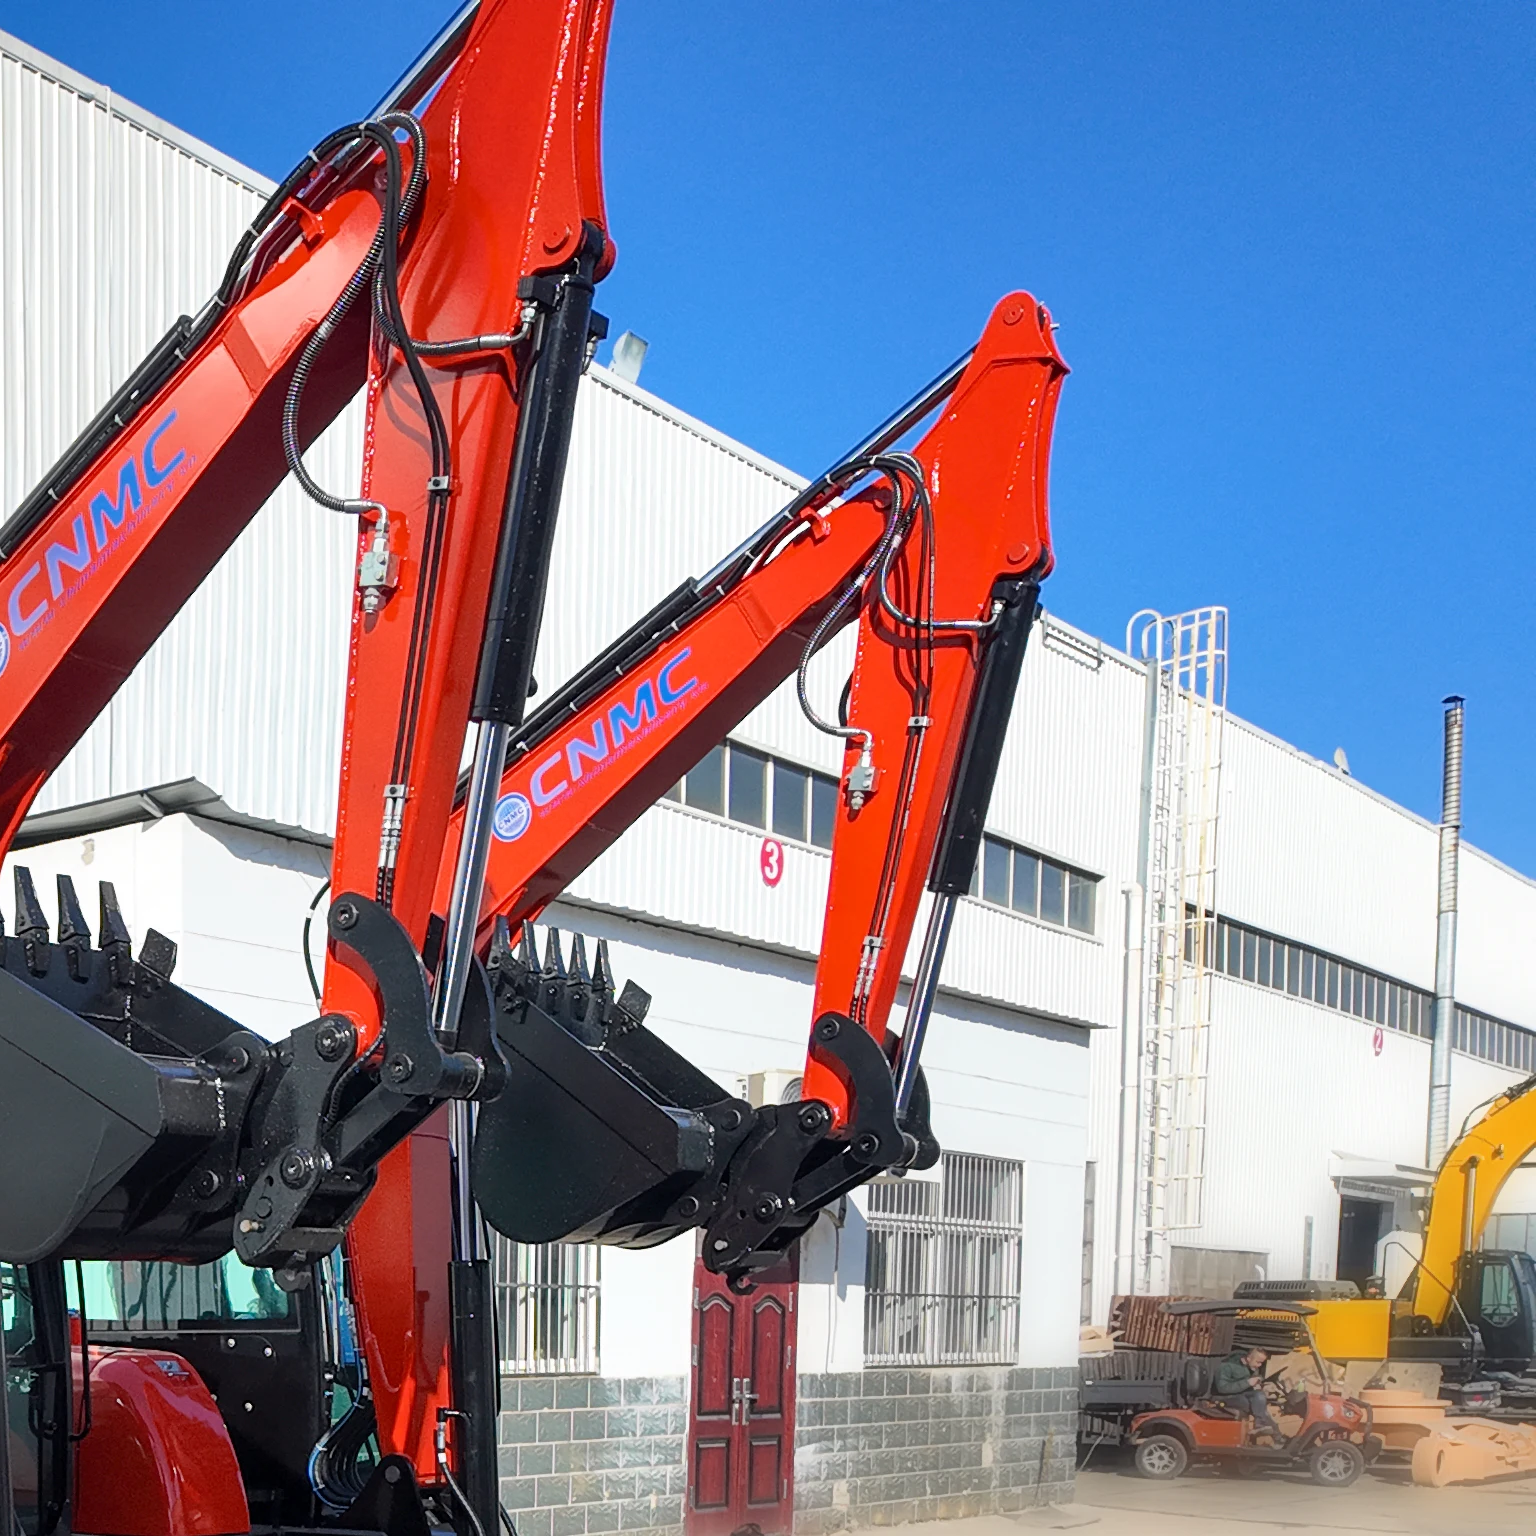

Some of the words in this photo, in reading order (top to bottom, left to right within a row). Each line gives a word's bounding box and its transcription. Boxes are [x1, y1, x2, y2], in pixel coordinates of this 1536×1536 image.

[7, 408, 187, 637] CNMC
[530, 646, 699, 807] CNMC
[498, 806, 524, 830] CNMC
[764, 841, 779, 880] 3
[1375, 1029, 1382, 1052] 2
